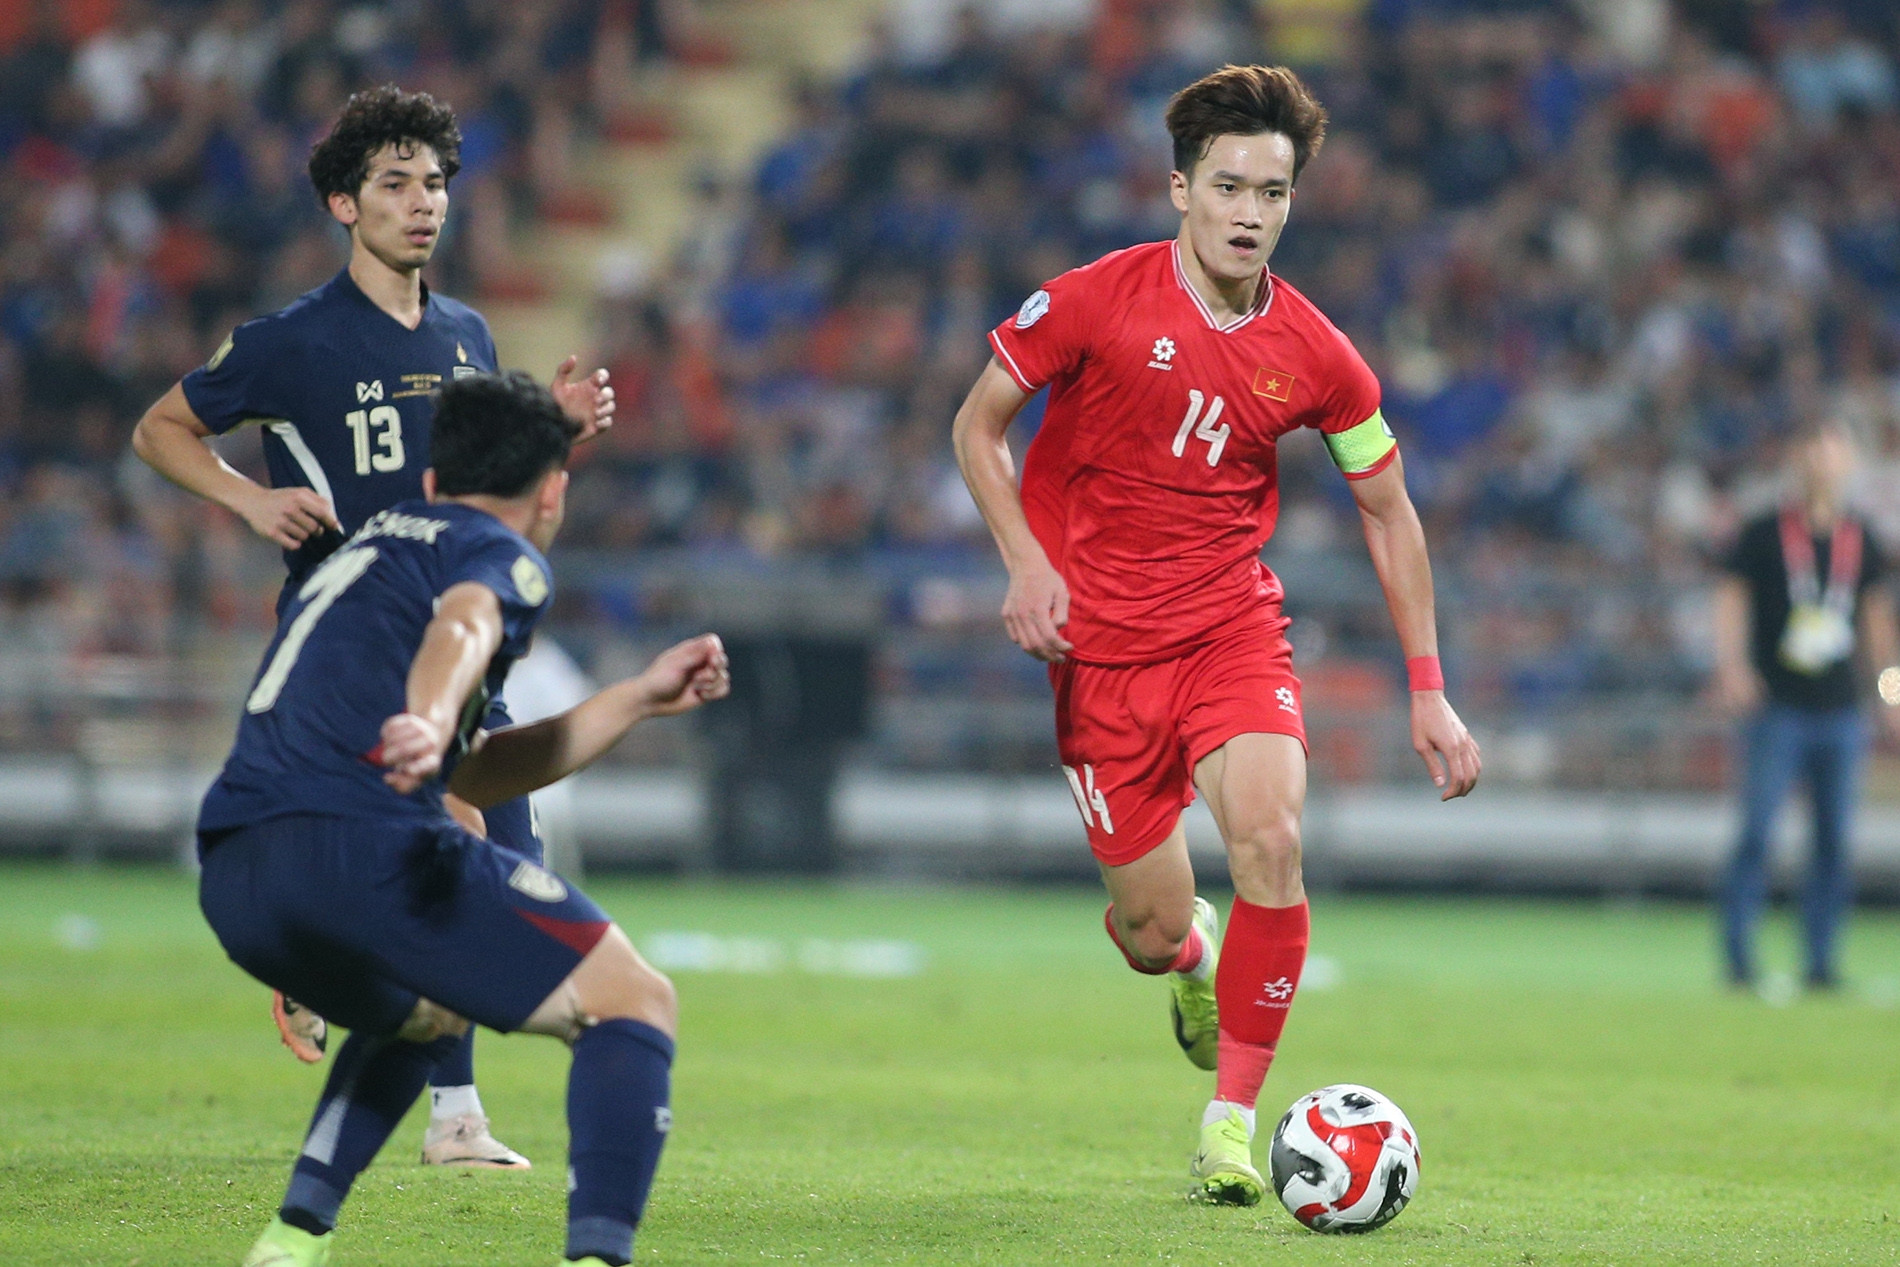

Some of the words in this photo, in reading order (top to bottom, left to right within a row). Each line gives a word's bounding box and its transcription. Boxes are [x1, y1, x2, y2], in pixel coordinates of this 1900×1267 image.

[345, 405, 406, 476] 13
[1171, 388, 1232, 468] 14
[1062, 763, 1115, 835] 14
